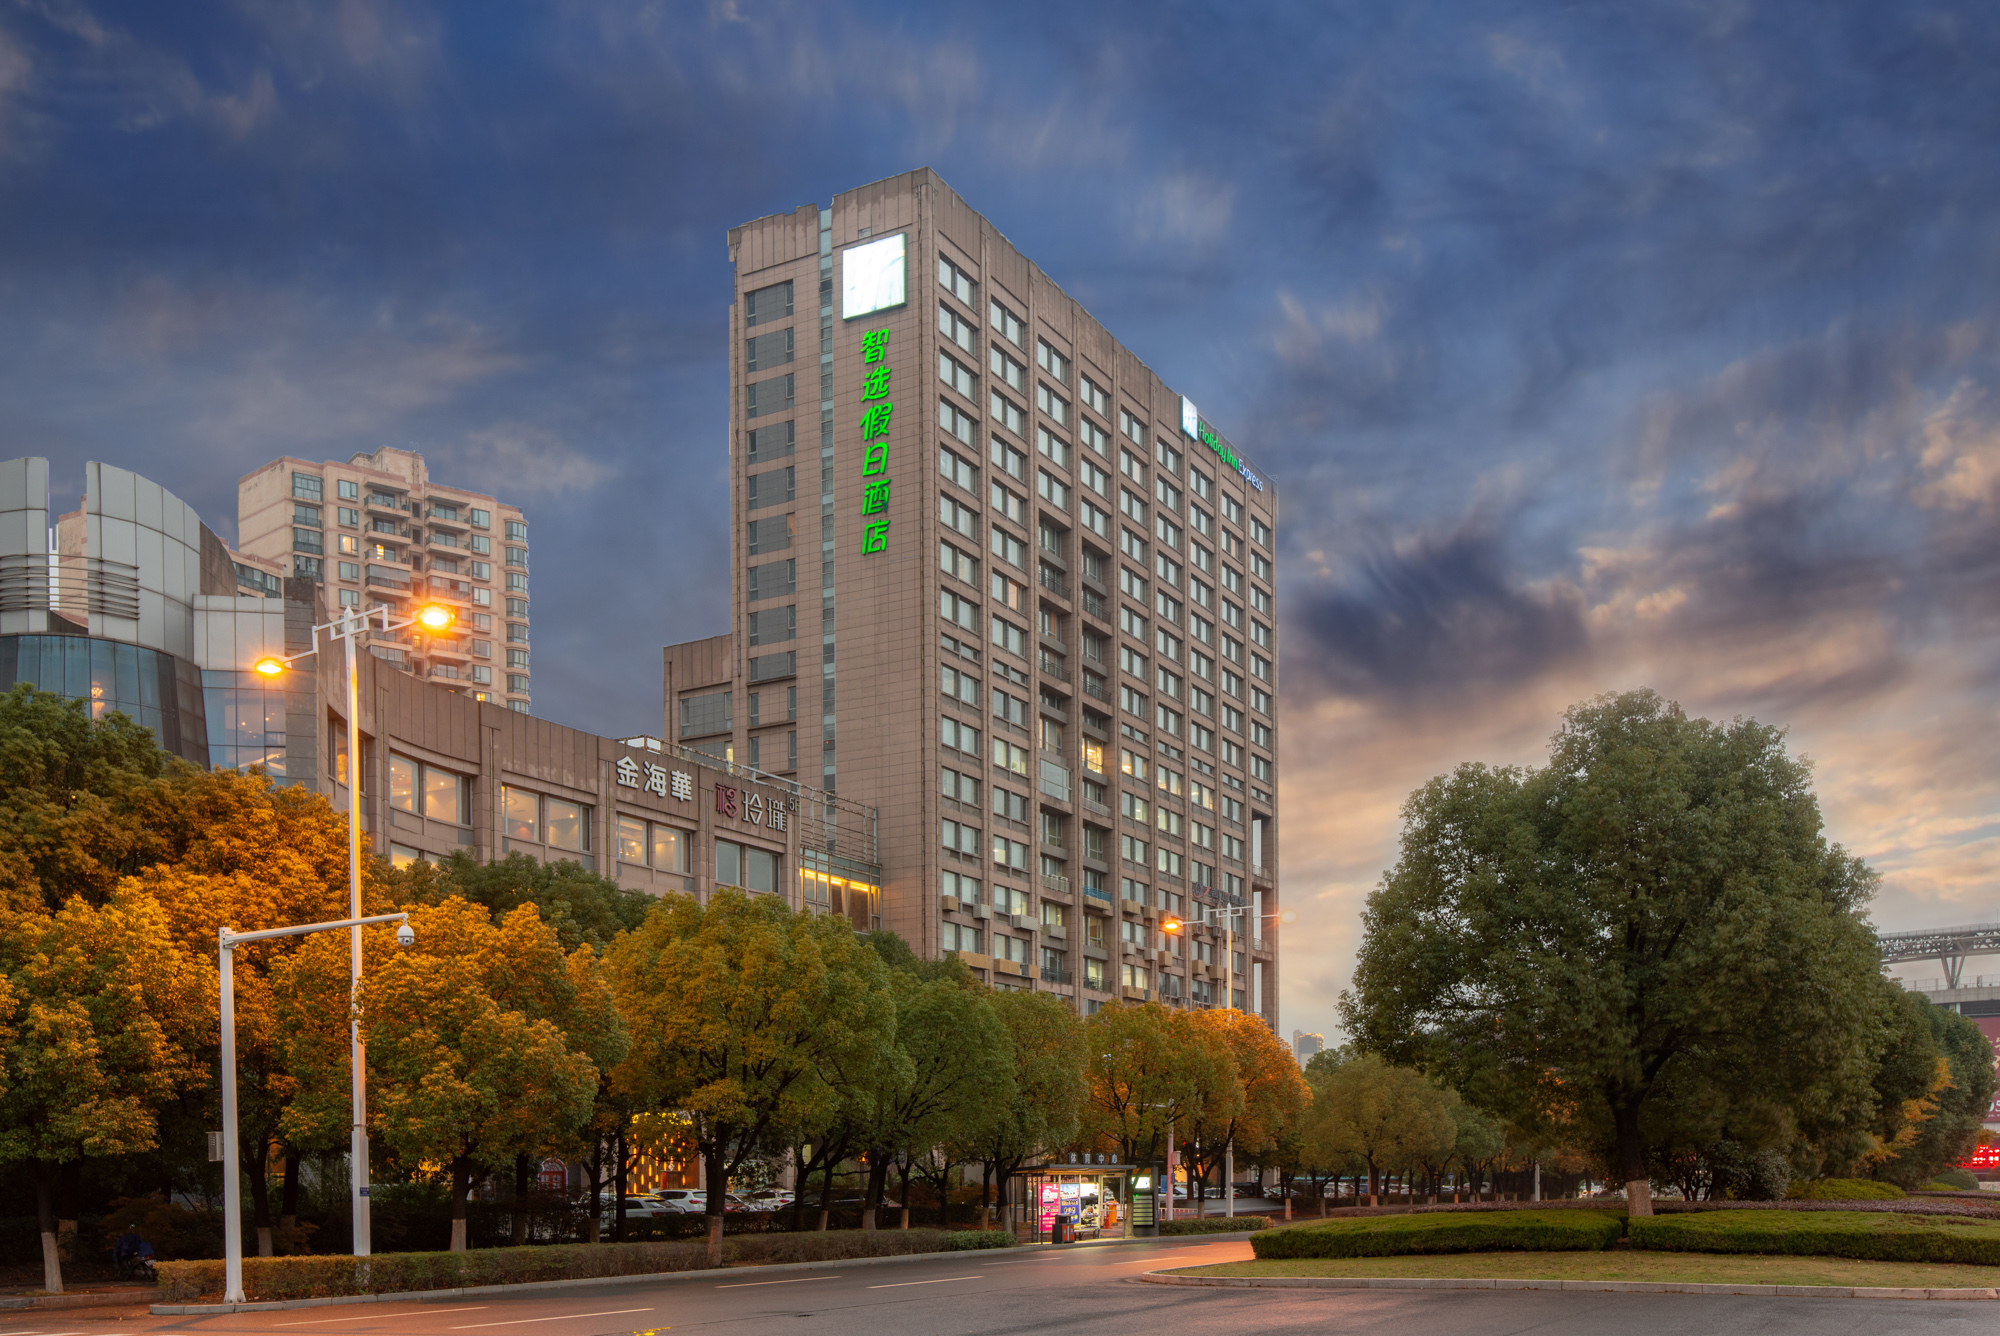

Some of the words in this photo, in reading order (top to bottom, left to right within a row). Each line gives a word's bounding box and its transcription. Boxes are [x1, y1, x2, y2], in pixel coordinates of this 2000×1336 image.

[859, 328, 893, 555] 智选假日酒店
[1198, 421, 1226, 463] Holiday
[1227, 447, 1238, 470] Inn
[1238, 458, 1263, 492] Express
[616, 755, 692, 802] 金海華
